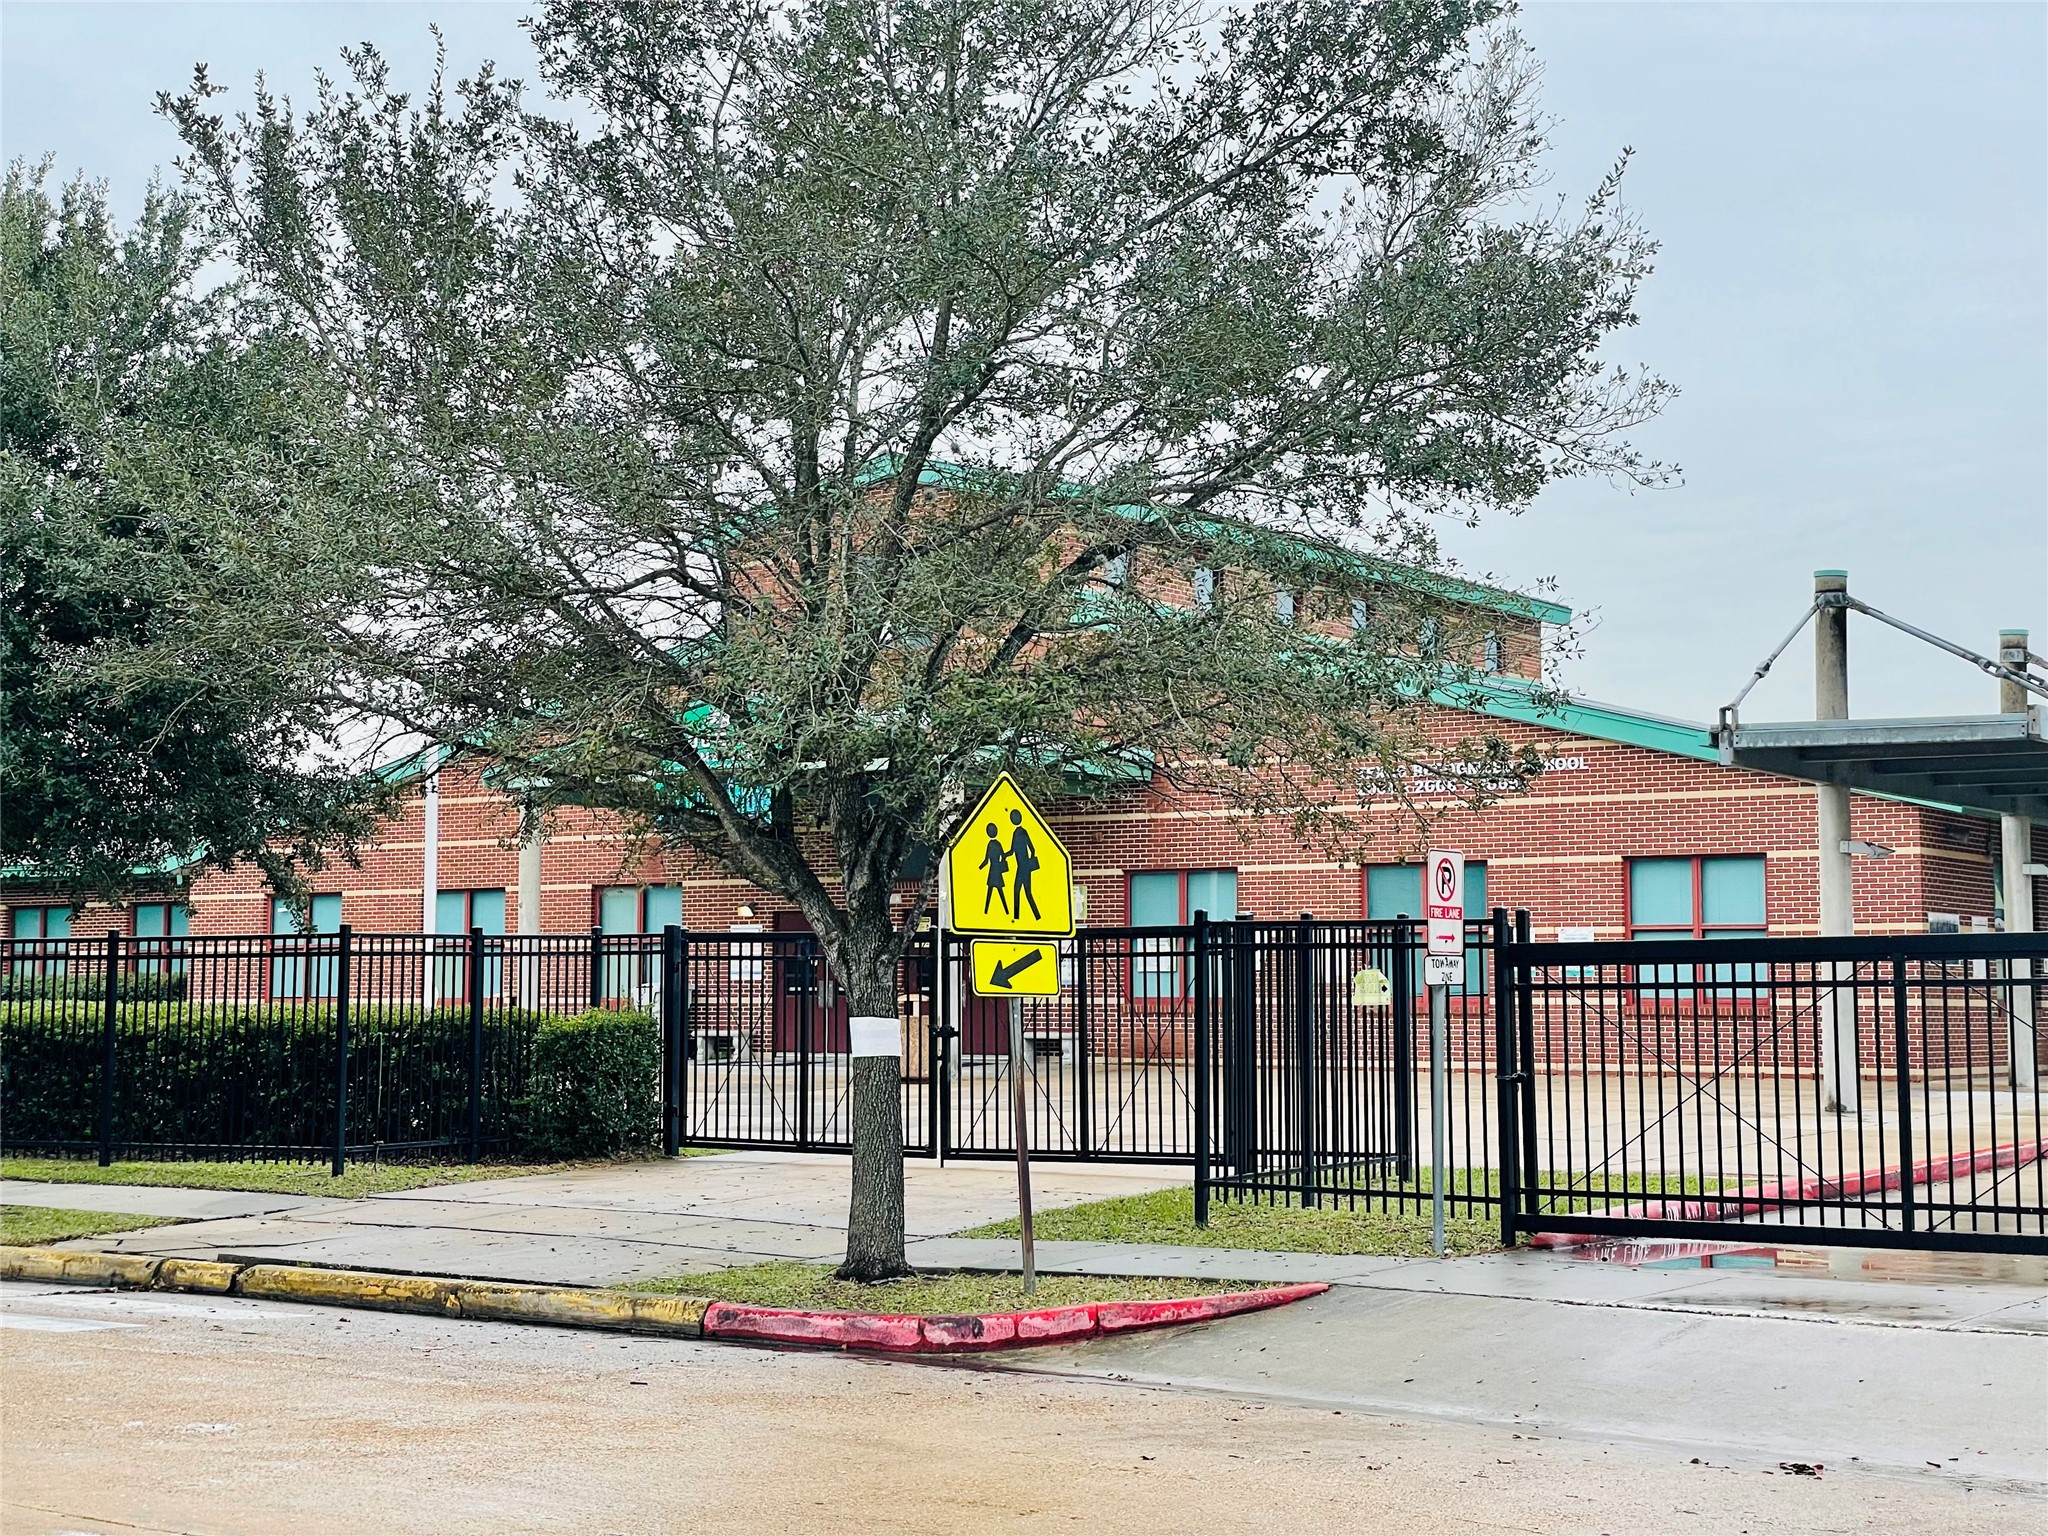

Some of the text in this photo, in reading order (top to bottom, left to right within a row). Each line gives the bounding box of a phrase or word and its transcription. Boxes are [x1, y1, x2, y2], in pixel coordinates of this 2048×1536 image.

[1430, 907, 1461, 919] FIRE LANE
[1441, 971, 1453, 982] ZNE
